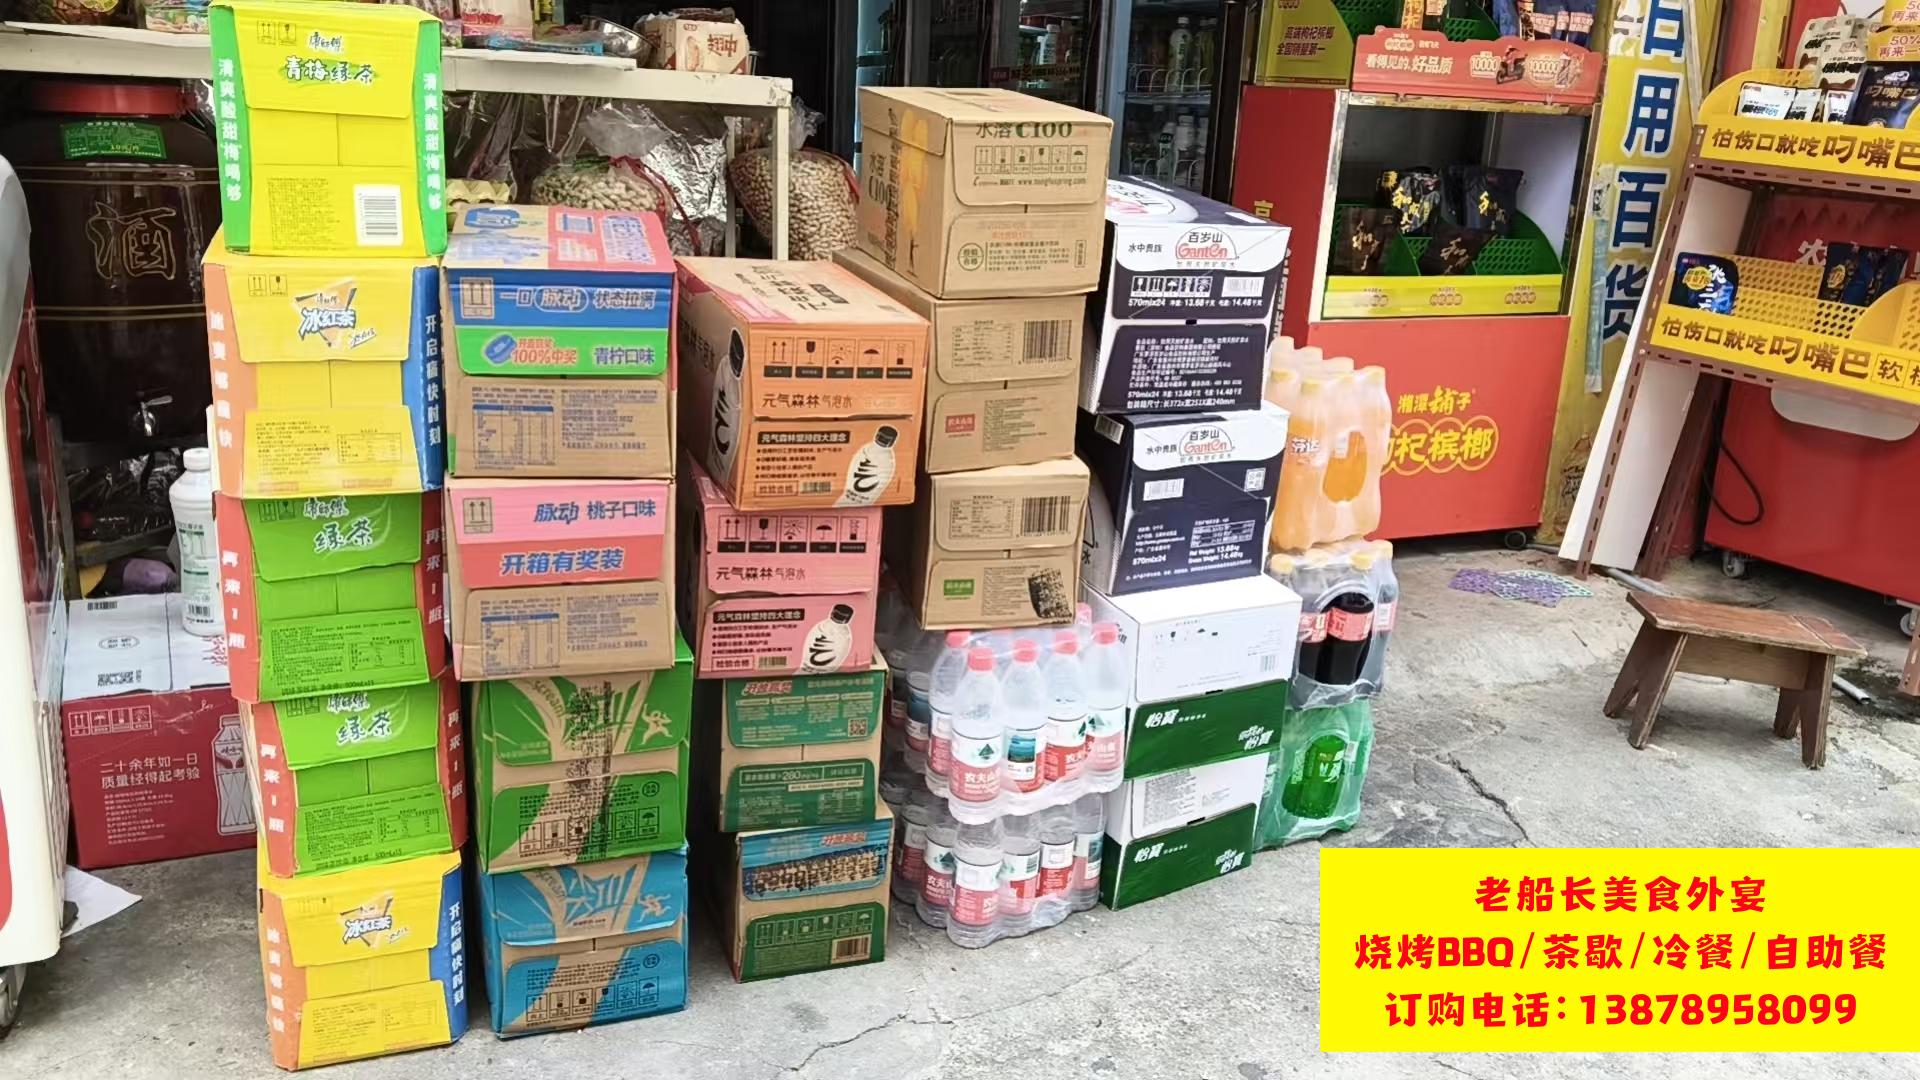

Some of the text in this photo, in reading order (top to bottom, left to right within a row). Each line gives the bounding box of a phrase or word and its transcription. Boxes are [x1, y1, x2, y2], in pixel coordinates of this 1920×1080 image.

[1879, 46, 1920, 57] 再来一
[285, 55, 374, 85] 青梅绿茶
[1711, 127, 1920, 172] 怕伤口就吃叼嘴巴
[86, 201, 178, 281] 酒
[1128, 243, 1164, 254] 水中贵族
[1188, 231, 1223, 244] 百岁山
[540, 288, 584, 311] 脉动
[299, 308, 356, 340] 冰红茶
[511, 349, 578, 365] 100%中奖
[594, 346, 656, 366] 青柠口味
[1661, 316, 1872, 381] 怕伤口就吃叼嘴巴
[425, 315, 441, 446] 开启痛快时刻
[1189, 430, 1220, 441] 百岁山
[1387, 427, 1494, 464] 杞槟榔
[534, 499, 656, 525] 脉动 桃子口味
[314, 519, 375, 555] 绿茶
[501, 548, 625, 577] 开箱有奖装
[336, 710, 393, 746] 绿茶
[100, 752, 198, 774] 二十余年如一日
[101, 766, 201, 791] 质量经得起考验
